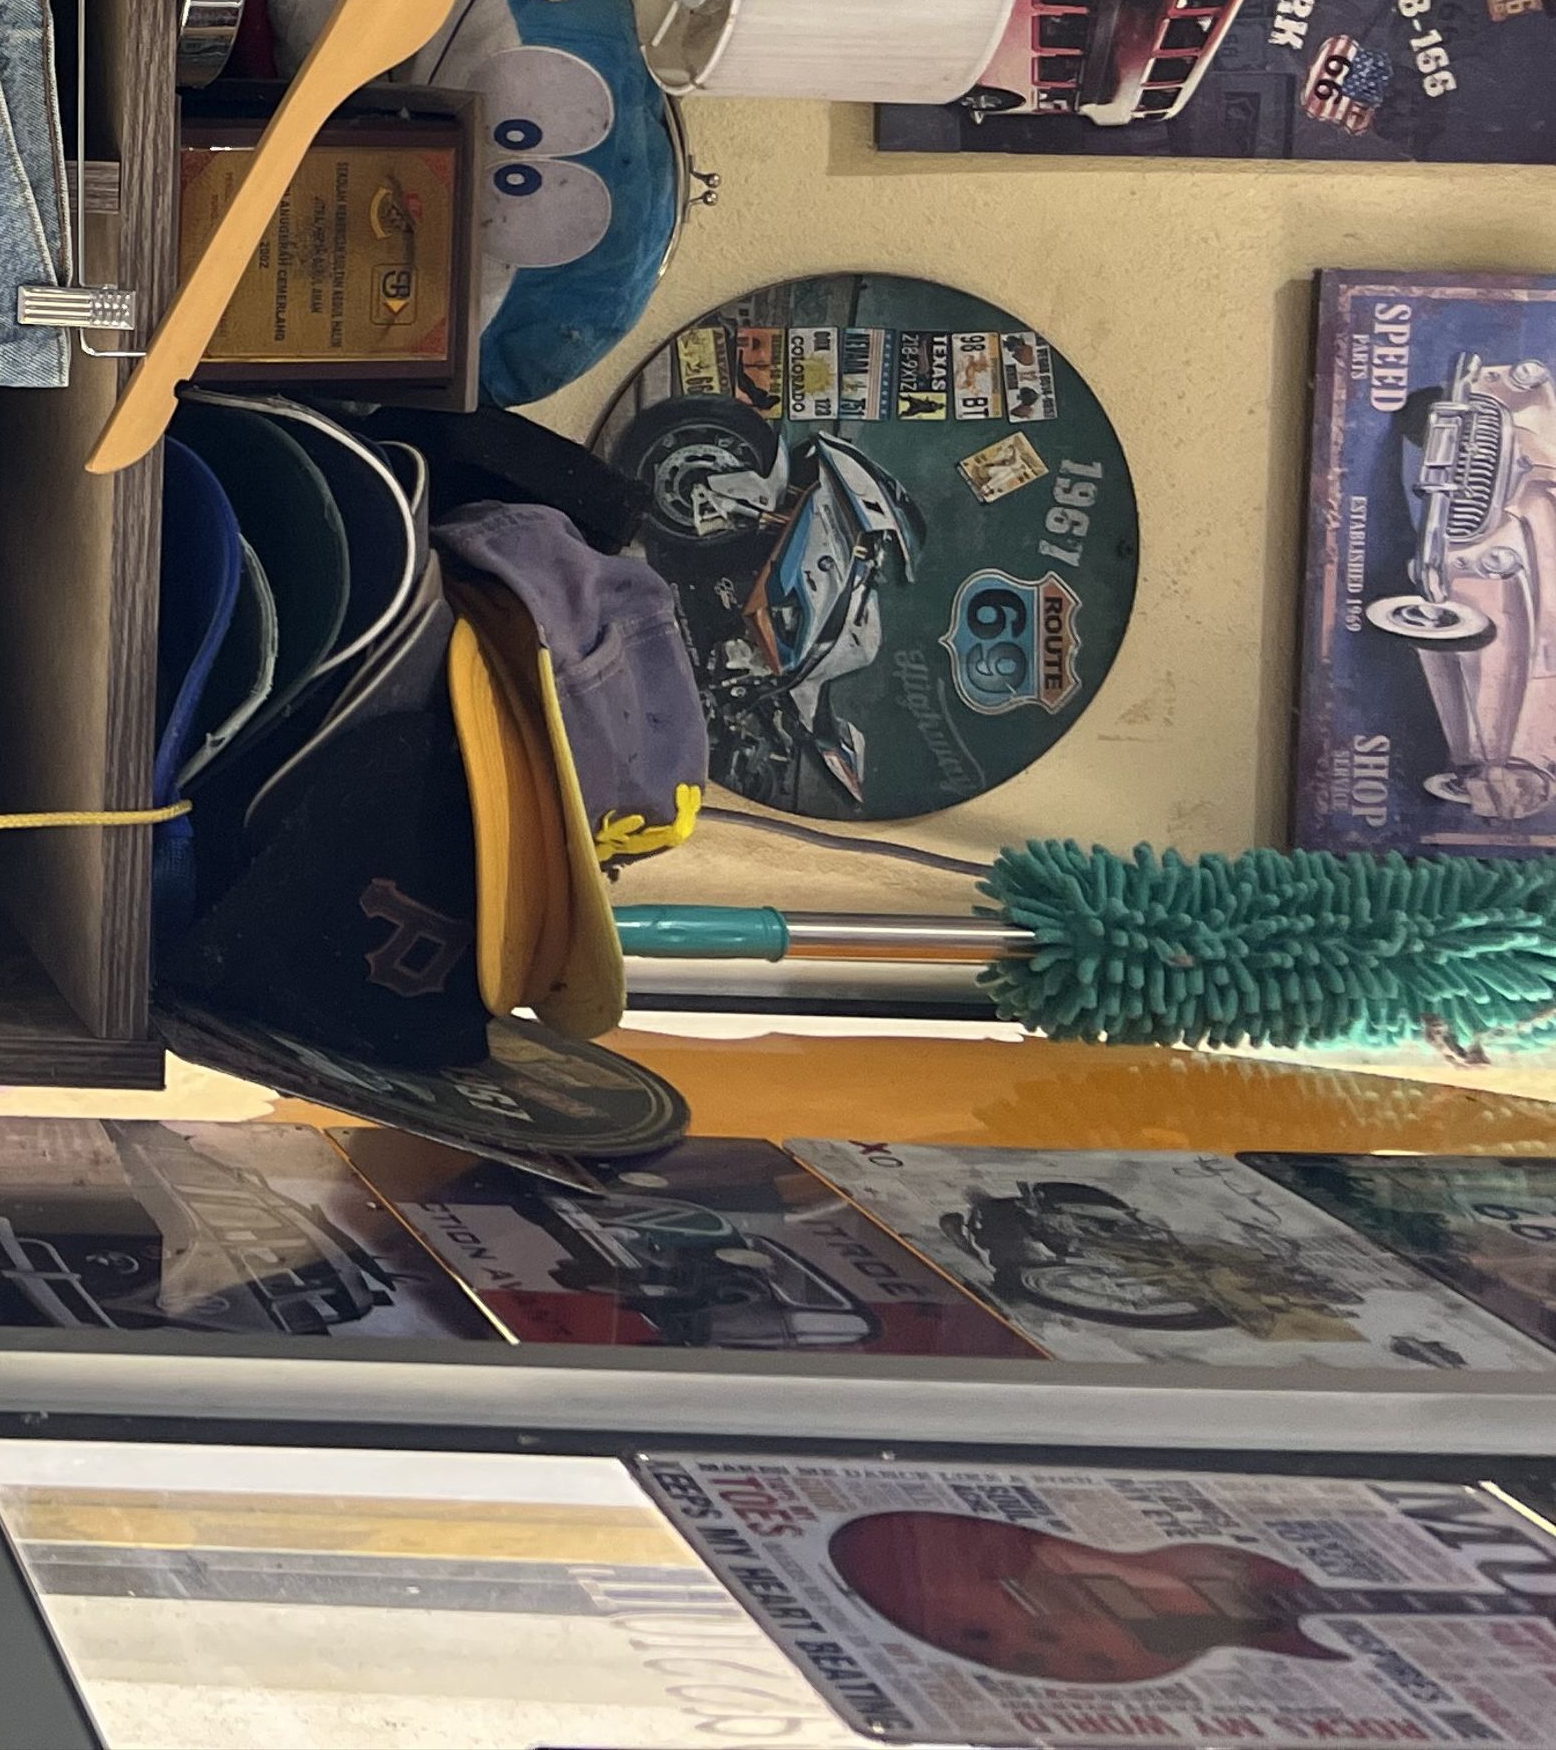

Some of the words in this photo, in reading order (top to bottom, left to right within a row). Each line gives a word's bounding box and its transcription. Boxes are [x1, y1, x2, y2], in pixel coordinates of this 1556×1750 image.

[1313, 54, 1353, 105] 66
[277, 200, 289, 266] ANUGERAH
[274, 270, 288, 342] CEMERLANG
[790, 335, 805, 413] COLORADO
[843, 333, 870, 375] NEVADA
[932, 335, 948, 391] TEXAS
[960, 335, 985, 352] 98
[1350, 334, 1370, 381] PARTS
[1369, 302, 1413, 413] SPEED
[962, 397, 989, 418] BT
[1038, 459, 1103, 567] 1967
[1346, 495, 1368, 594] ESTABLISHED
[965, 588, 1027, 695] 69
[1043, 596, 1064, 692] ROUTE
[1344, 598, 1363, 633] 1969
[1331, 750, 1351, 812] SERVICE
[1351, 734, 1391, 827] SHOP
[702, 1475, 812, 1538] TOES
[973, 1485, 1044, 1522] SOUL
[695, 1526, 766, 1559] MY
[728, 1566, 829, 1632] HEART
[793, 1640, 918, 1729] BEATING
